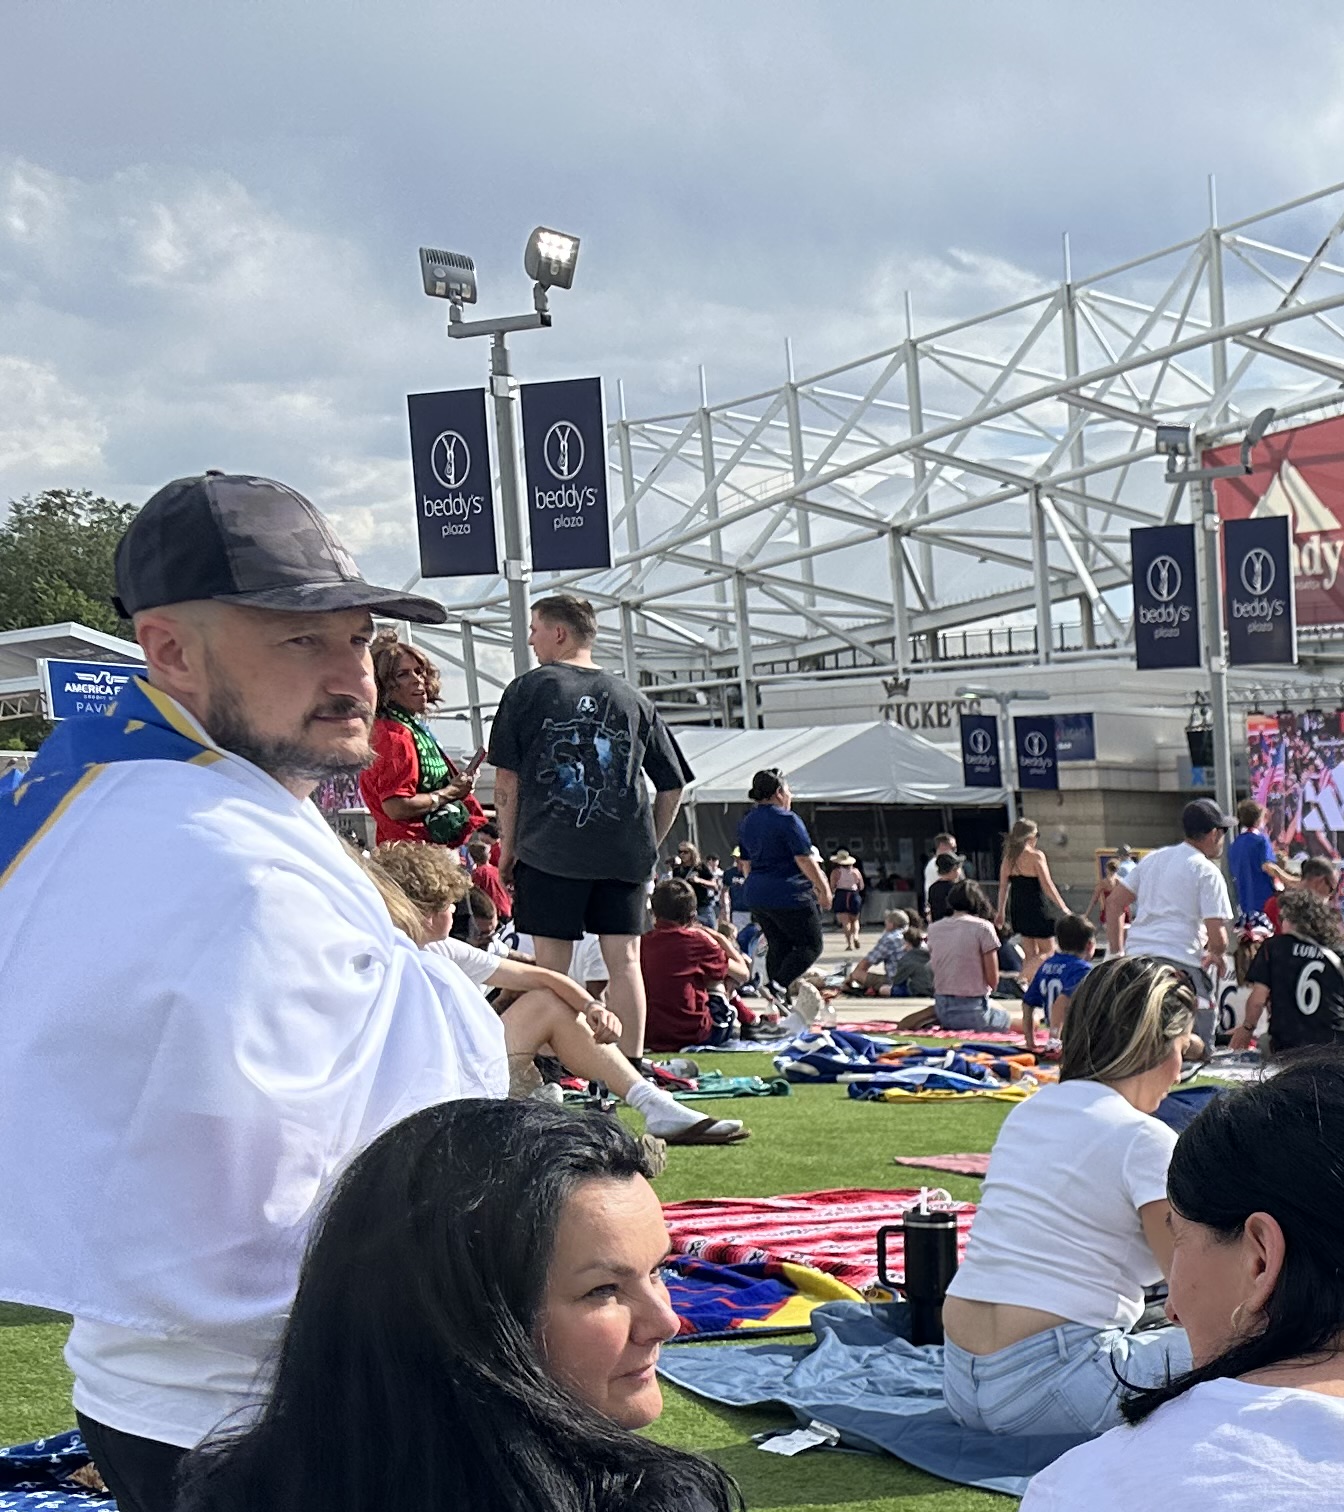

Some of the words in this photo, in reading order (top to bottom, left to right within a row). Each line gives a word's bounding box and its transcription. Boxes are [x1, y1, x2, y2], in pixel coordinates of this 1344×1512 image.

[423, 492, 483, 521] beddy's
[534, 483, 597, 514] beddy's
[441, 521, 471, 539] plaza
[553, 514, 584, 532] plaza
[1139, 603, 1191, 627] beddy's
[1232, 598, 1285, 621] beddy's
[1296, 961, 1325, 1015] 6
